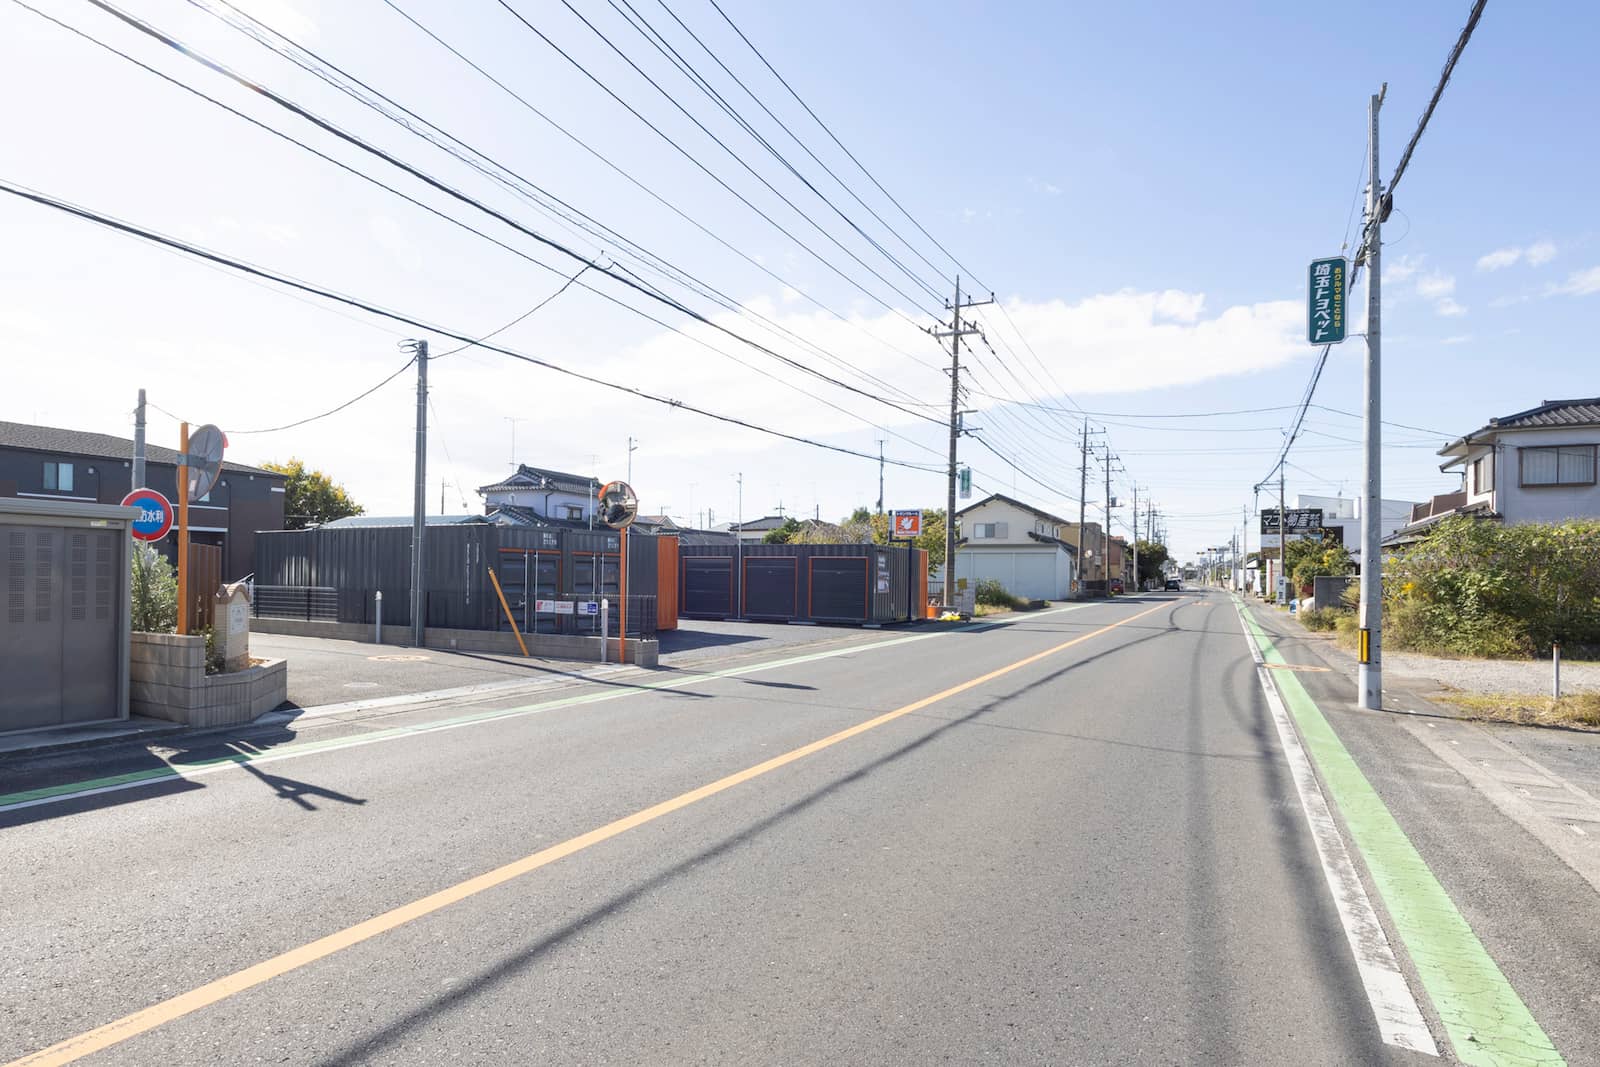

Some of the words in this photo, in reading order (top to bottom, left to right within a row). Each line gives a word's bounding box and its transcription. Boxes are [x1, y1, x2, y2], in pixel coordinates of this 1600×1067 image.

[1314, 264, 1331, 340] 埼玉トヨペット
[135, 509, 164, 523] 防水利
